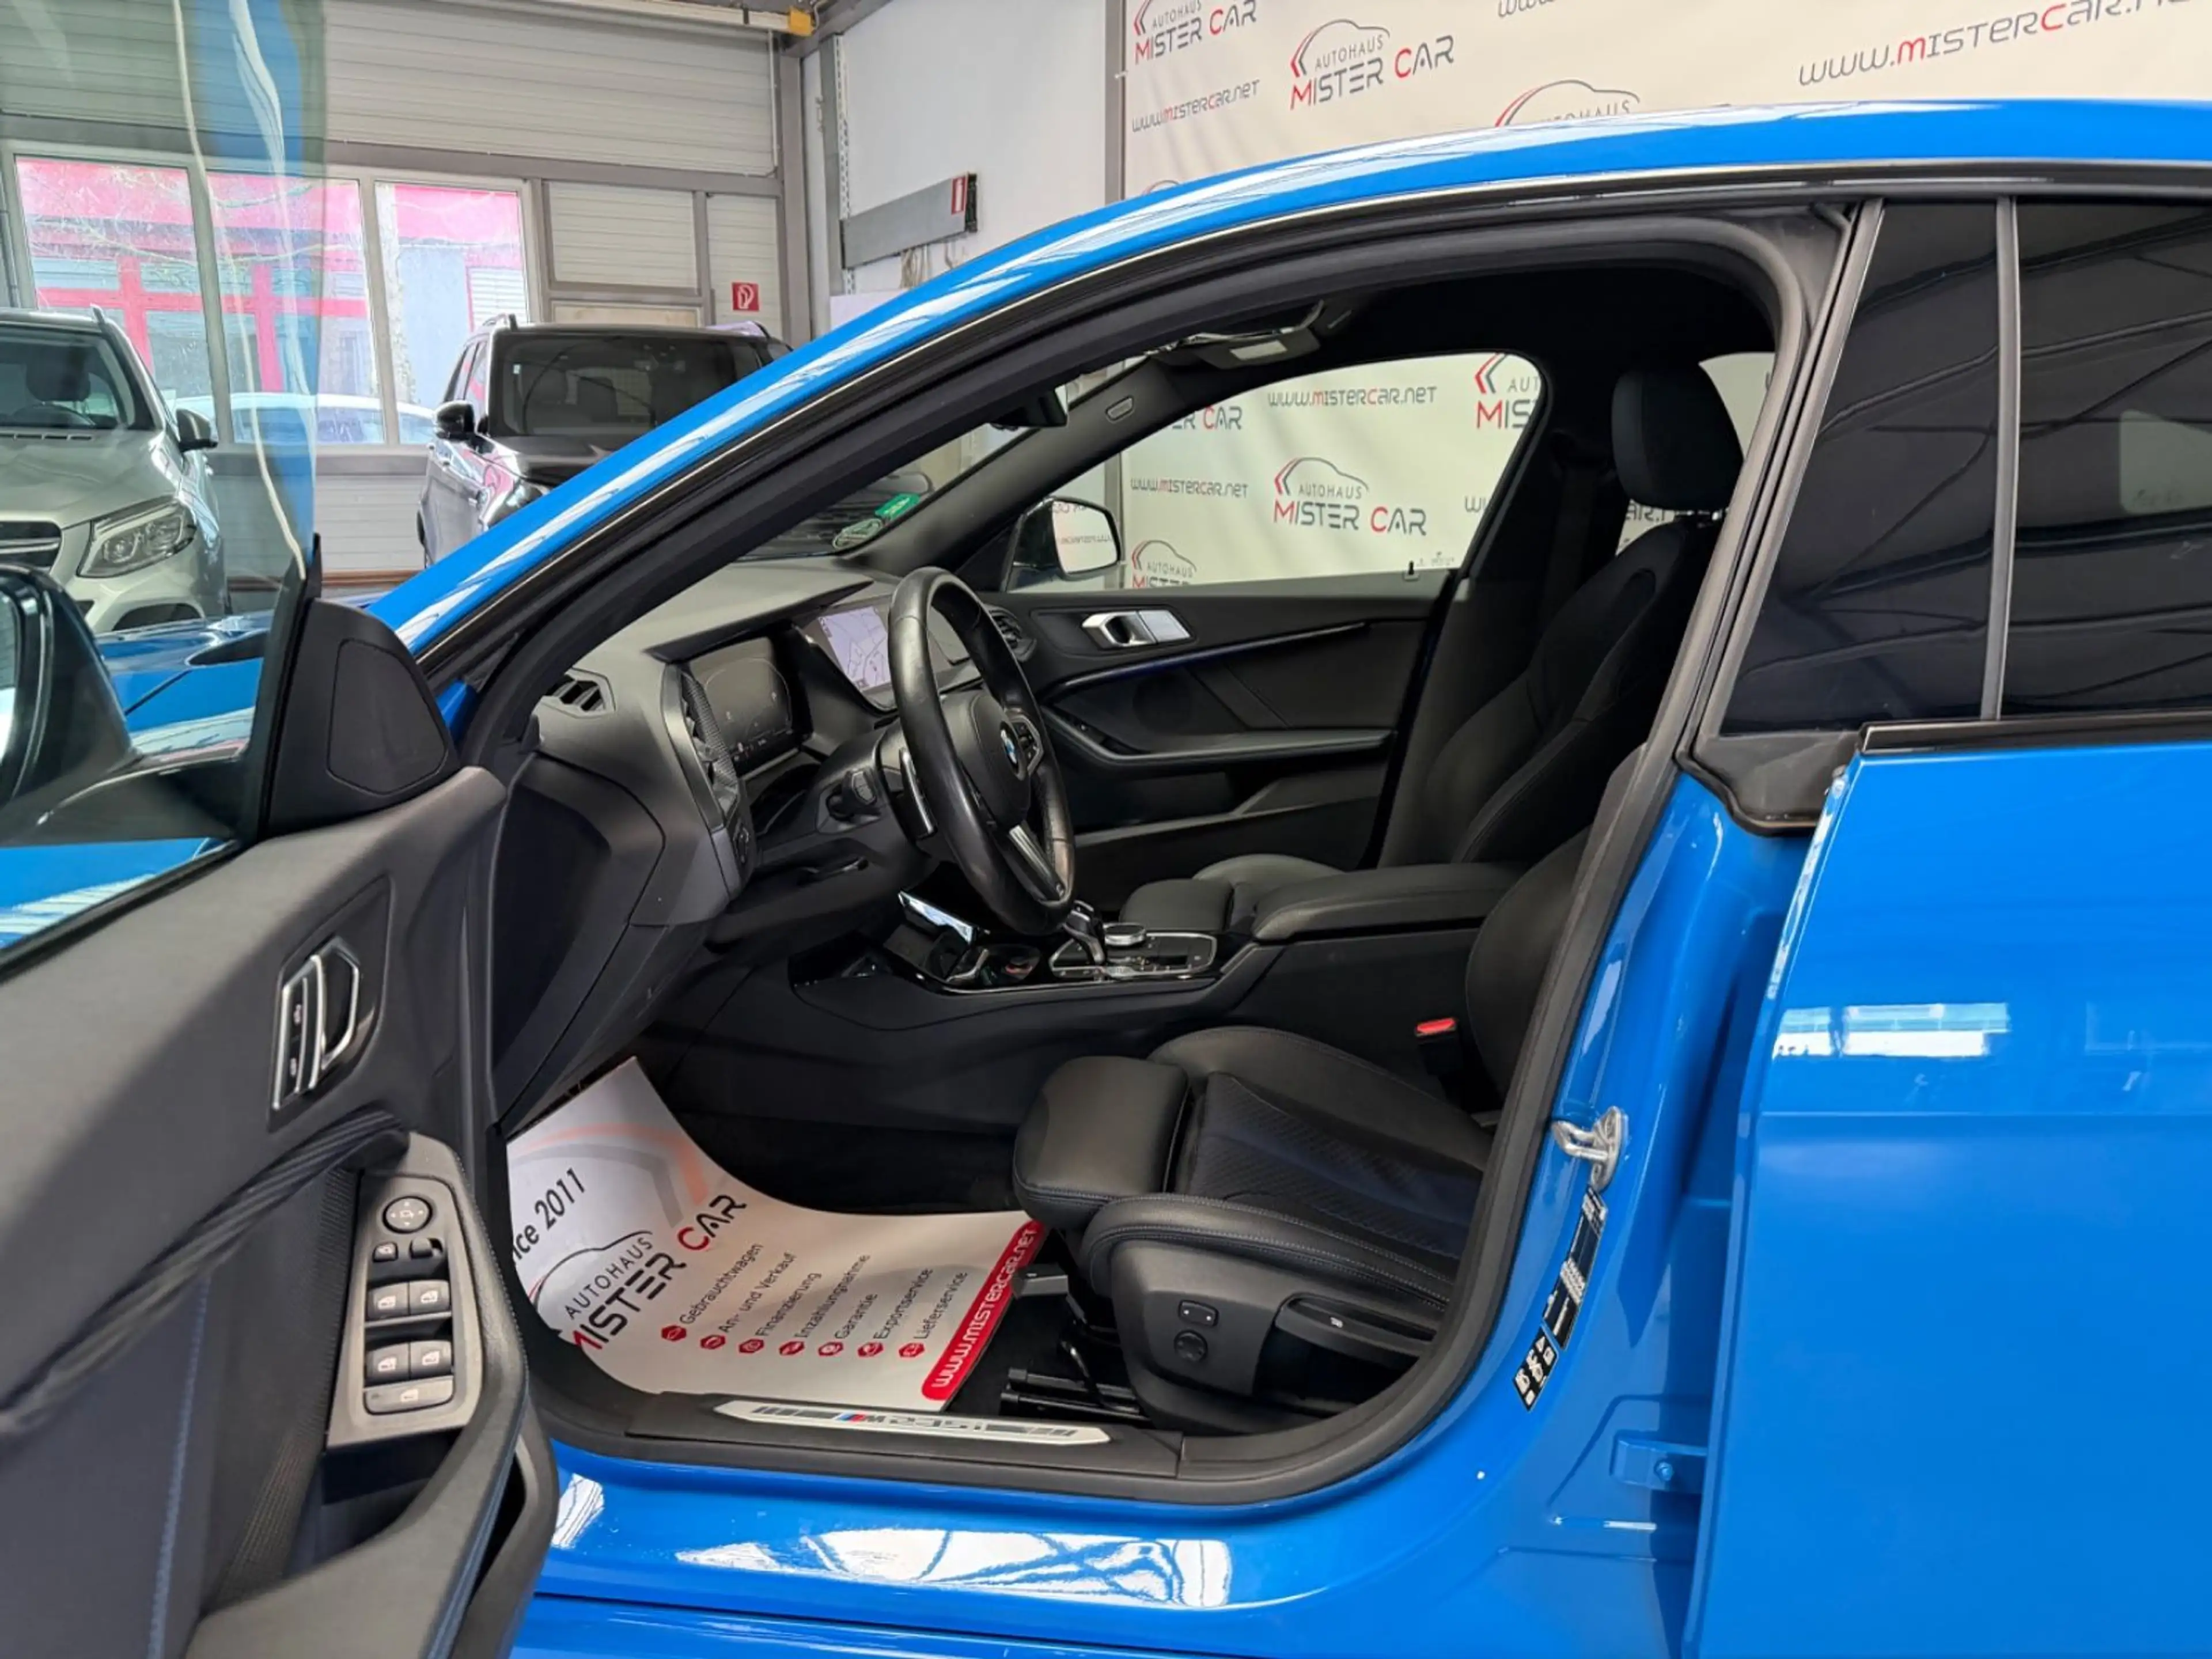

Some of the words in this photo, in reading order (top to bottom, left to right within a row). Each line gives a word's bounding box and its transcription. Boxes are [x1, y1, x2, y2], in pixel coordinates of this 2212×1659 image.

[1135, 17, 1202, 65] MISTER
[1209, 0, 1257, 35] CAR
[1315, 34, 1384, 70] AUTOHAUS
[1290, 58, 1384, 110] MISTER
[1394, 35, 1455, 78] CAR
[1203, 405, 1243, 430] CAR
[1476, 399, 1537, 430] MIS
[1274, 499, 1360, 530] MISTER
[1370, 506, 1427, 536] CAR
[1298, 484, 1362, 499] AUTOHAUS
[535, 1167, 585, 1230] 2011
[677, 1195, 747, 1250] CAR
[565, 1237, 653, 1319] AUTOHAUS
[679, 1243, 764, 1325] Gebrauchtwagen
[738, 1290, 763, 1313] und
[754, 1251, 797, 1290] Verkauf
[755, 1272, 823, 1336] Finanzierung
[873, 1268, 933, 1339] Exportservice
[913, 1271, 968, 1339] Lieferservice
[834, 1293, 878, 1339] Garantie
